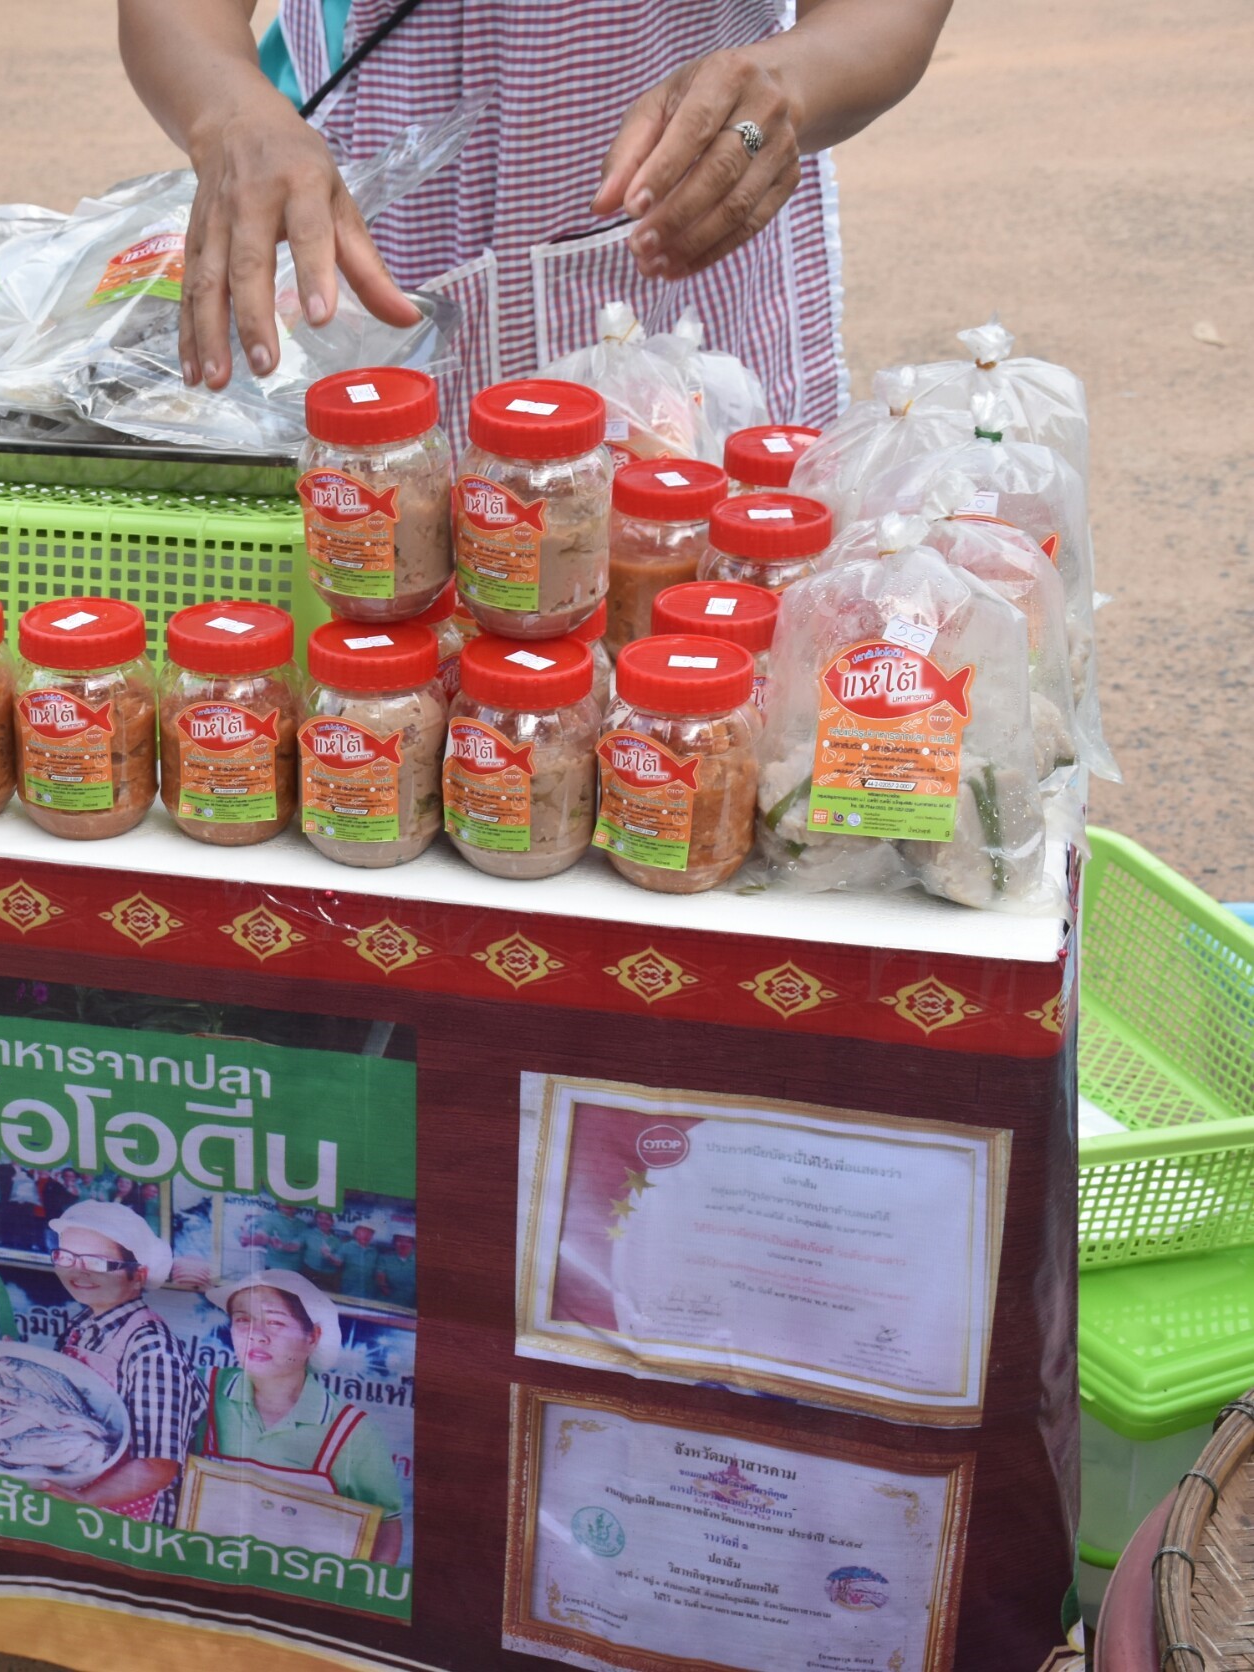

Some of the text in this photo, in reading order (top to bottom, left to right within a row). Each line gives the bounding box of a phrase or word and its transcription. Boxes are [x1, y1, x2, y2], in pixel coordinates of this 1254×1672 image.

[313, 485, 357, 508] แห่ใต้
[894, 624, 926, 643] 50
[843, 661, 918, 699] แห่ใต้
[29, 702, 74, 727] แห่ใต้
[928, 715, 953, 724] OTOP
[192, 715, 243, 739] แห่ใต้
[314, 731, 362, 755] แห่ใต้
[612, 749, 657, 774] แห่ใต้
[642, 1139, 682, 1150] OTOP
[674, 1441, 798, 1482] จังหวัดมหาสารคาม
[76, 1507, 412, 1601] จ.มหาสารคาม
[708, 1551, 742, 1571] ปลาส้ม
